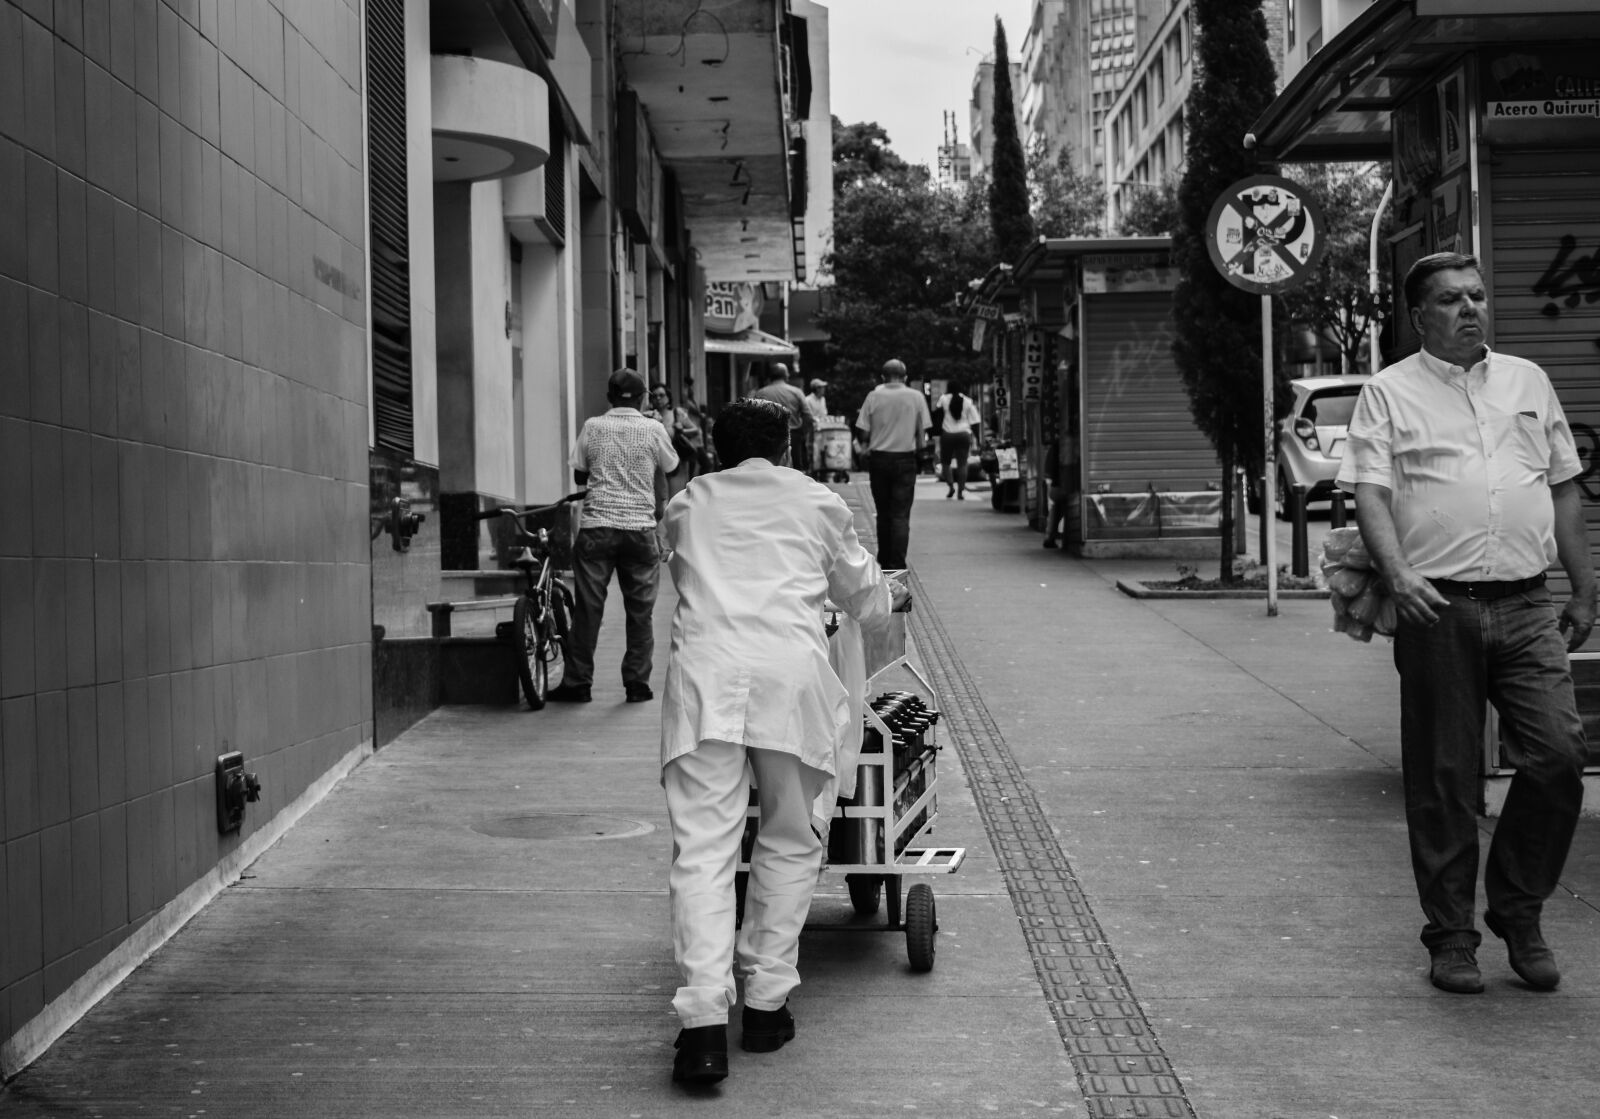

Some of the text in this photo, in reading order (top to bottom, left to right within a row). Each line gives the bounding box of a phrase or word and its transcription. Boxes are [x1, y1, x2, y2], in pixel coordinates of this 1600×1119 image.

[1495, 102, 1538, 116] Acero
[704, 294, 734, 315] Pan
[995, 377, 1008, 407] 100
